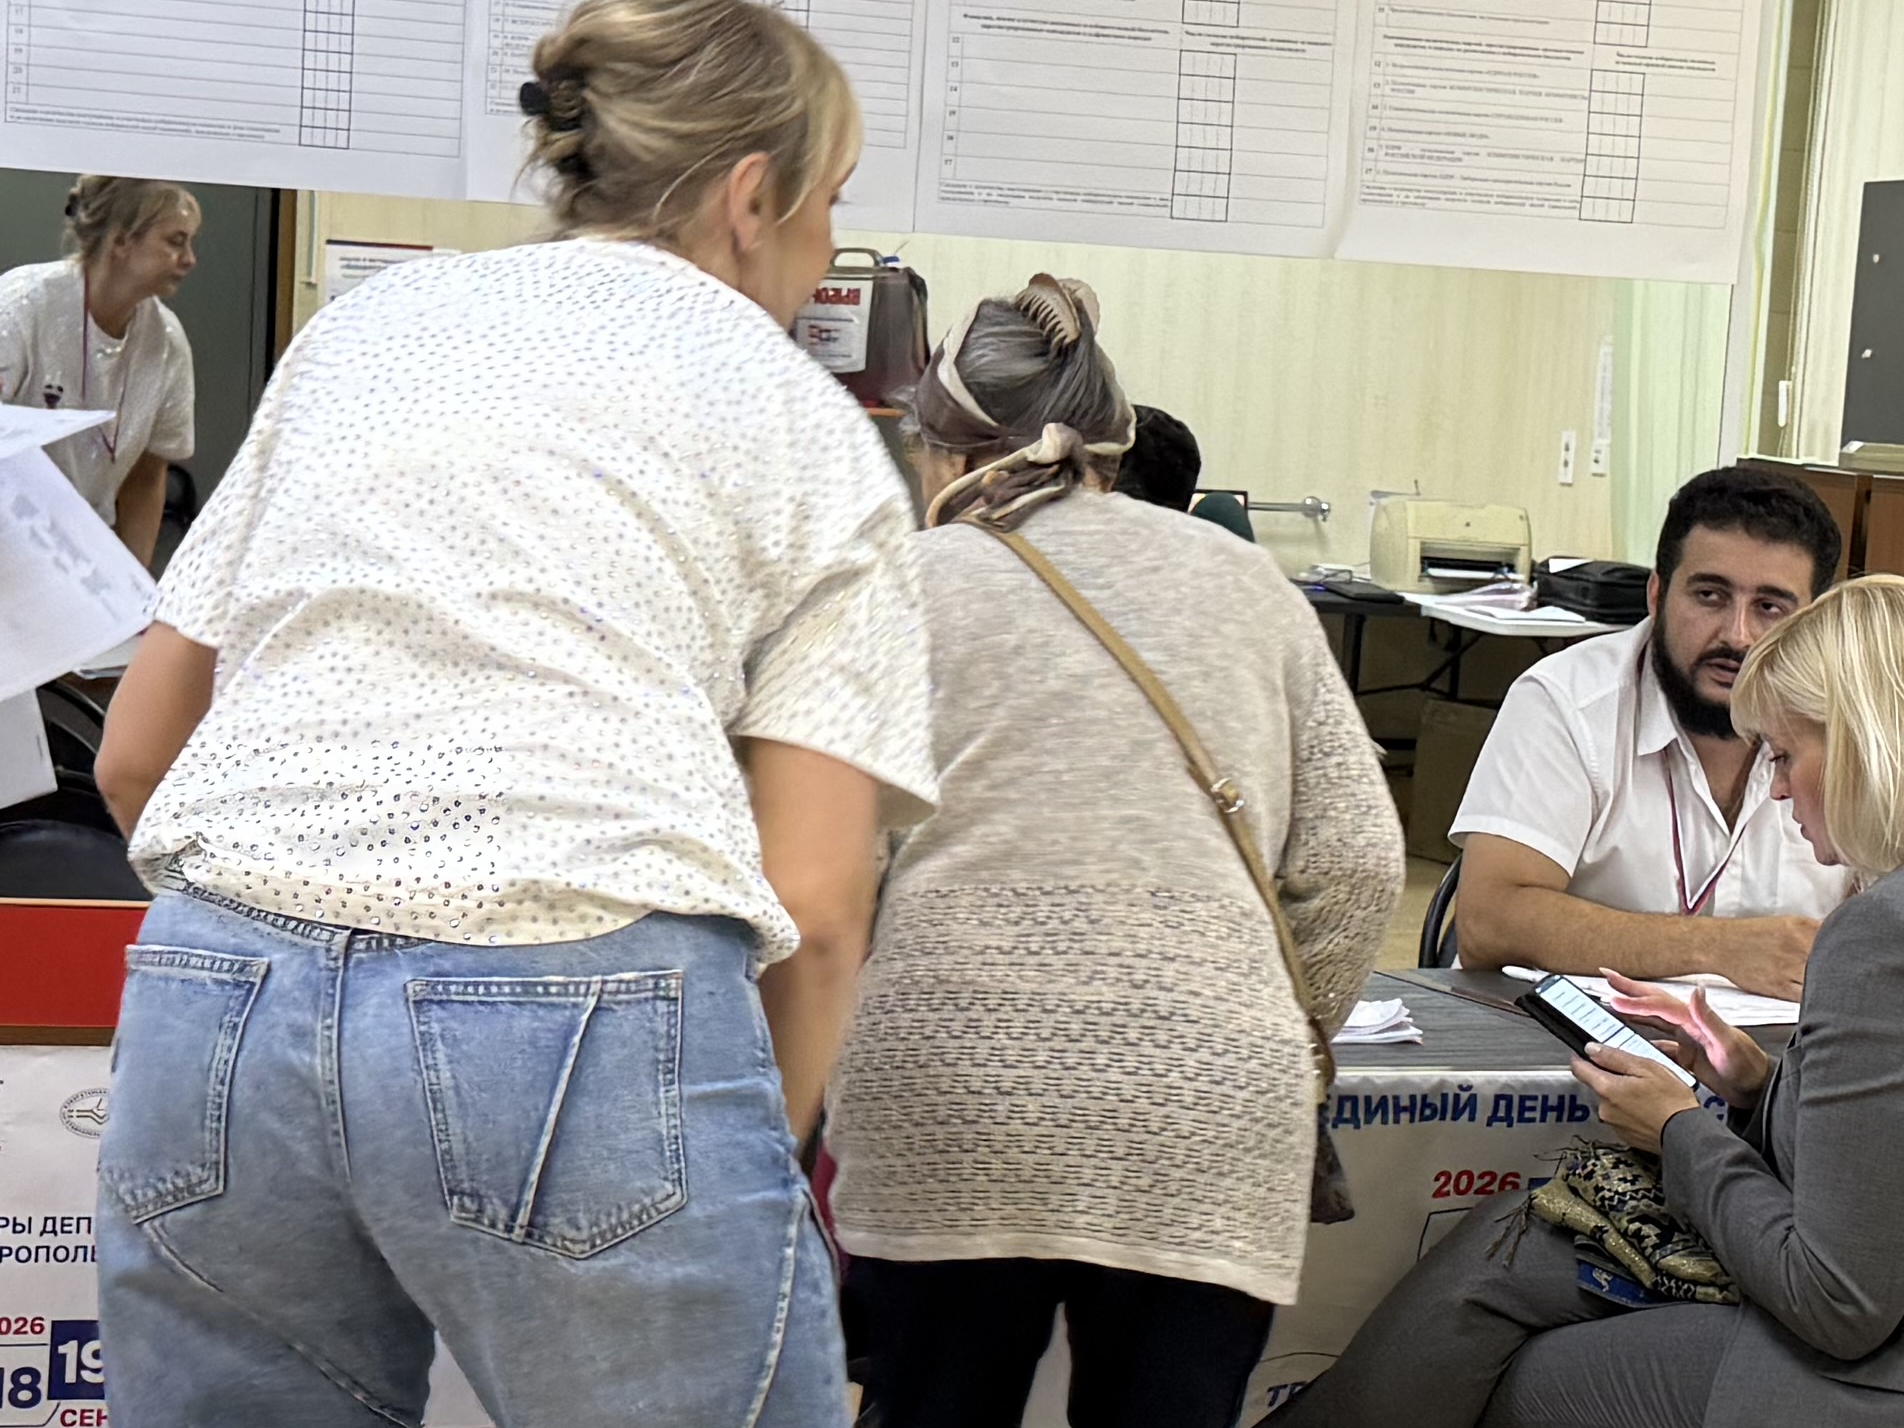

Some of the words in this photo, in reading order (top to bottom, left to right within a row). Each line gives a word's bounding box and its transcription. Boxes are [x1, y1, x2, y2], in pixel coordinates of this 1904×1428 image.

[1329, 1084, 1478, 1129] ДИНЫЙ
[1486, 1093, 1590, 1128] ДЕНЬ
[1432, 1169, 1521, 1198] 2026
[39, 1216, 92, 1237] ДЕП
[57, 1339, 105, 1384] 19
